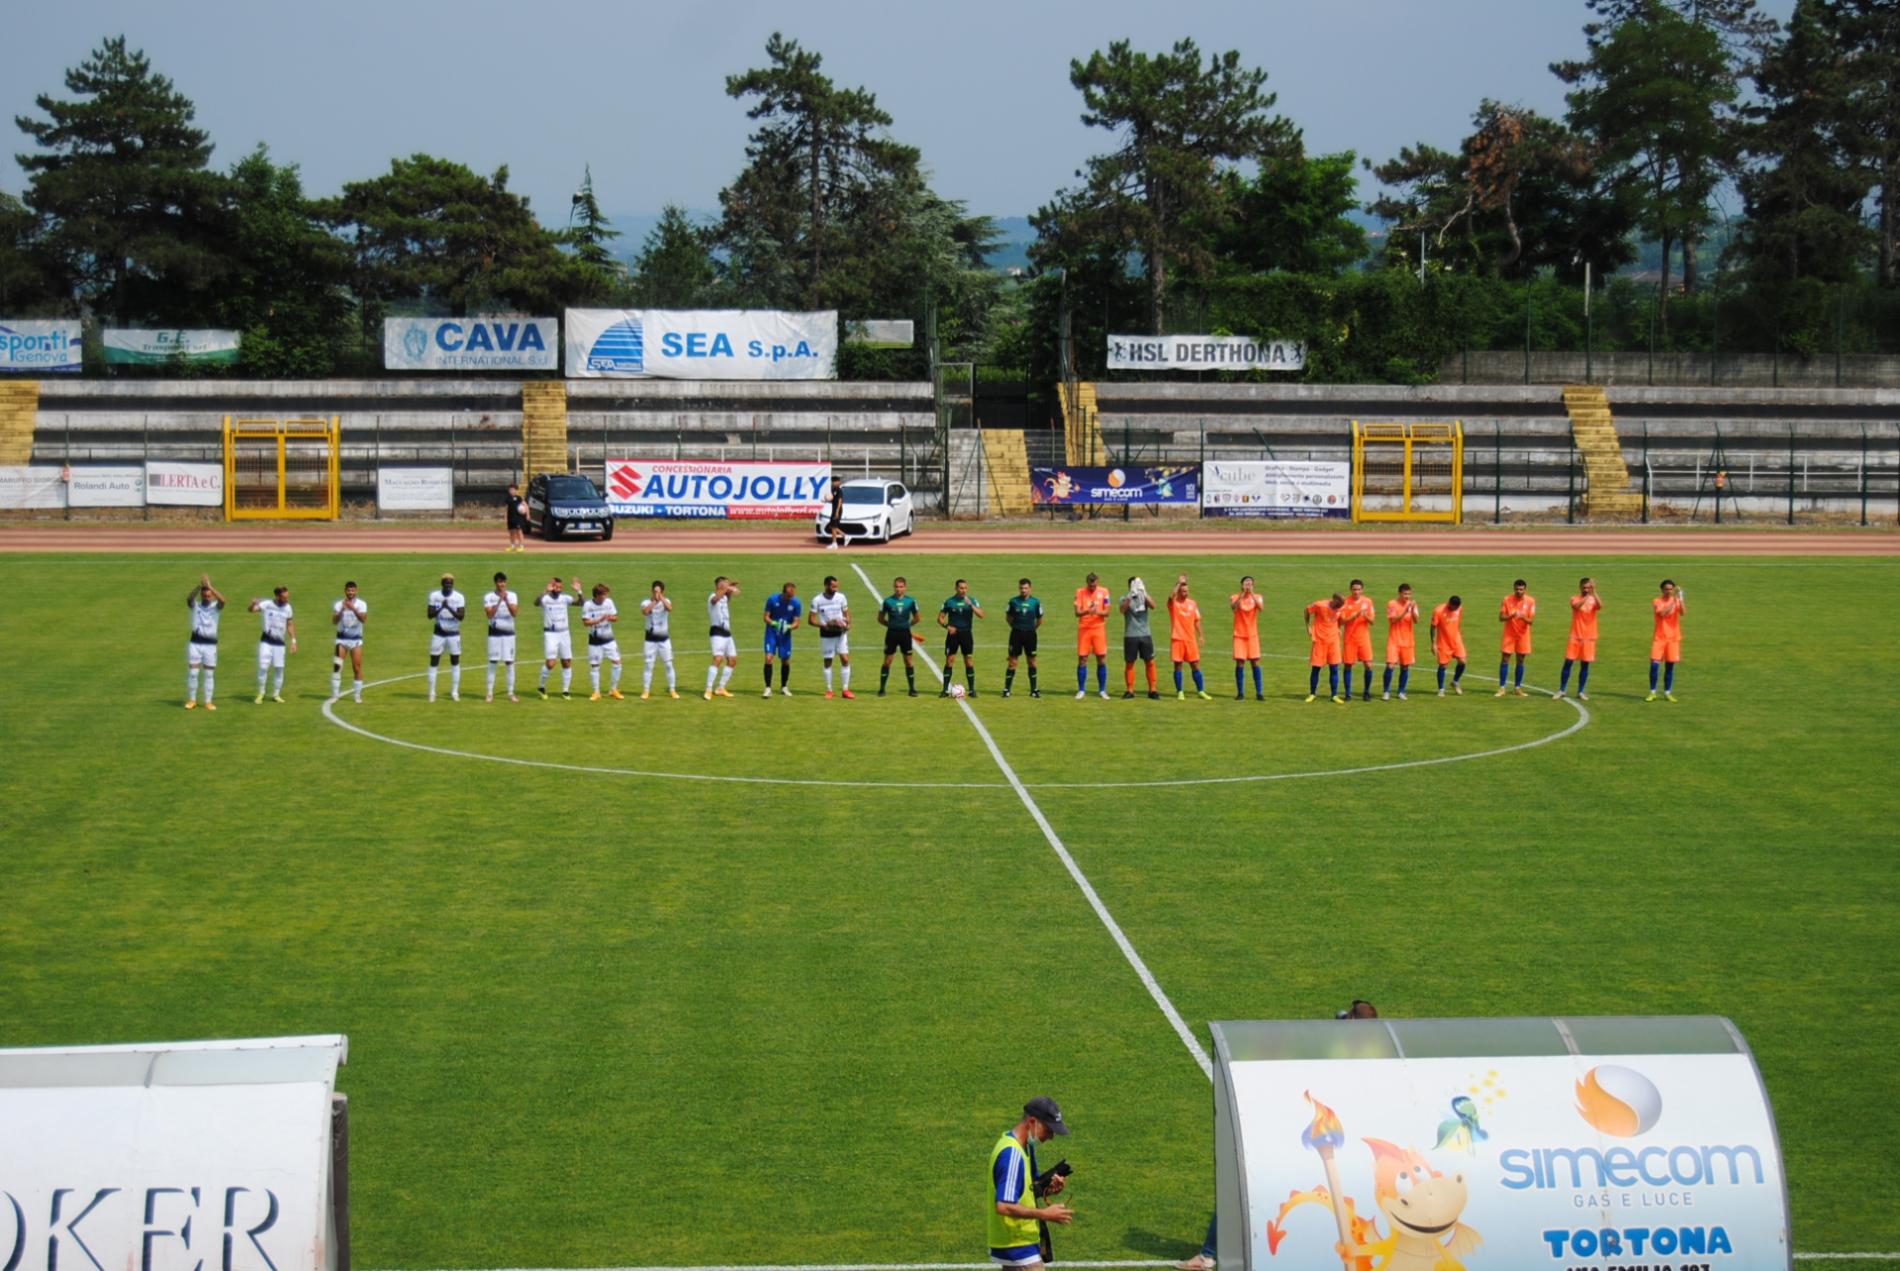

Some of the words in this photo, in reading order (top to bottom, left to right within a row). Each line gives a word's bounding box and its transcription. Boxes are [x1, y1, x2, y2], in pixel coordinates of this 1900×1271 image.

[435, 323, 546, 352] CAVA
[16, 349, 68, 362] Genova
[661, 332, 735, 358] SEA
[748, 340, 819, 362] S.p.A.
[1129, 343, 1169, 362] HSL
[1175, 343, 1286, 363] DERTHONA
[436, 355, 526, 366] INTERNATIONAL
[652, 465, 732, 474] CONCESSIONARIA
[74, 481, 107, 490] Rolandi
[109, 481, 130, 490] Auto
[641, 475, 829, 500] AUTOJOLLY
[1090, 487, 1143, 498] simecom
[609, 503, 654, 515] SUZUKI
[665, 504, 726, 516] TORTONA
[1499, 1144, 1765, 1190] simecom
[1573, 1193, 1611, 1208] GAS
[1621, 1192, 1632, 1207] E
[1642, 1191, 1693, 1207] LUCE
[1543, 1226, 1733, 1258] TORTONA
